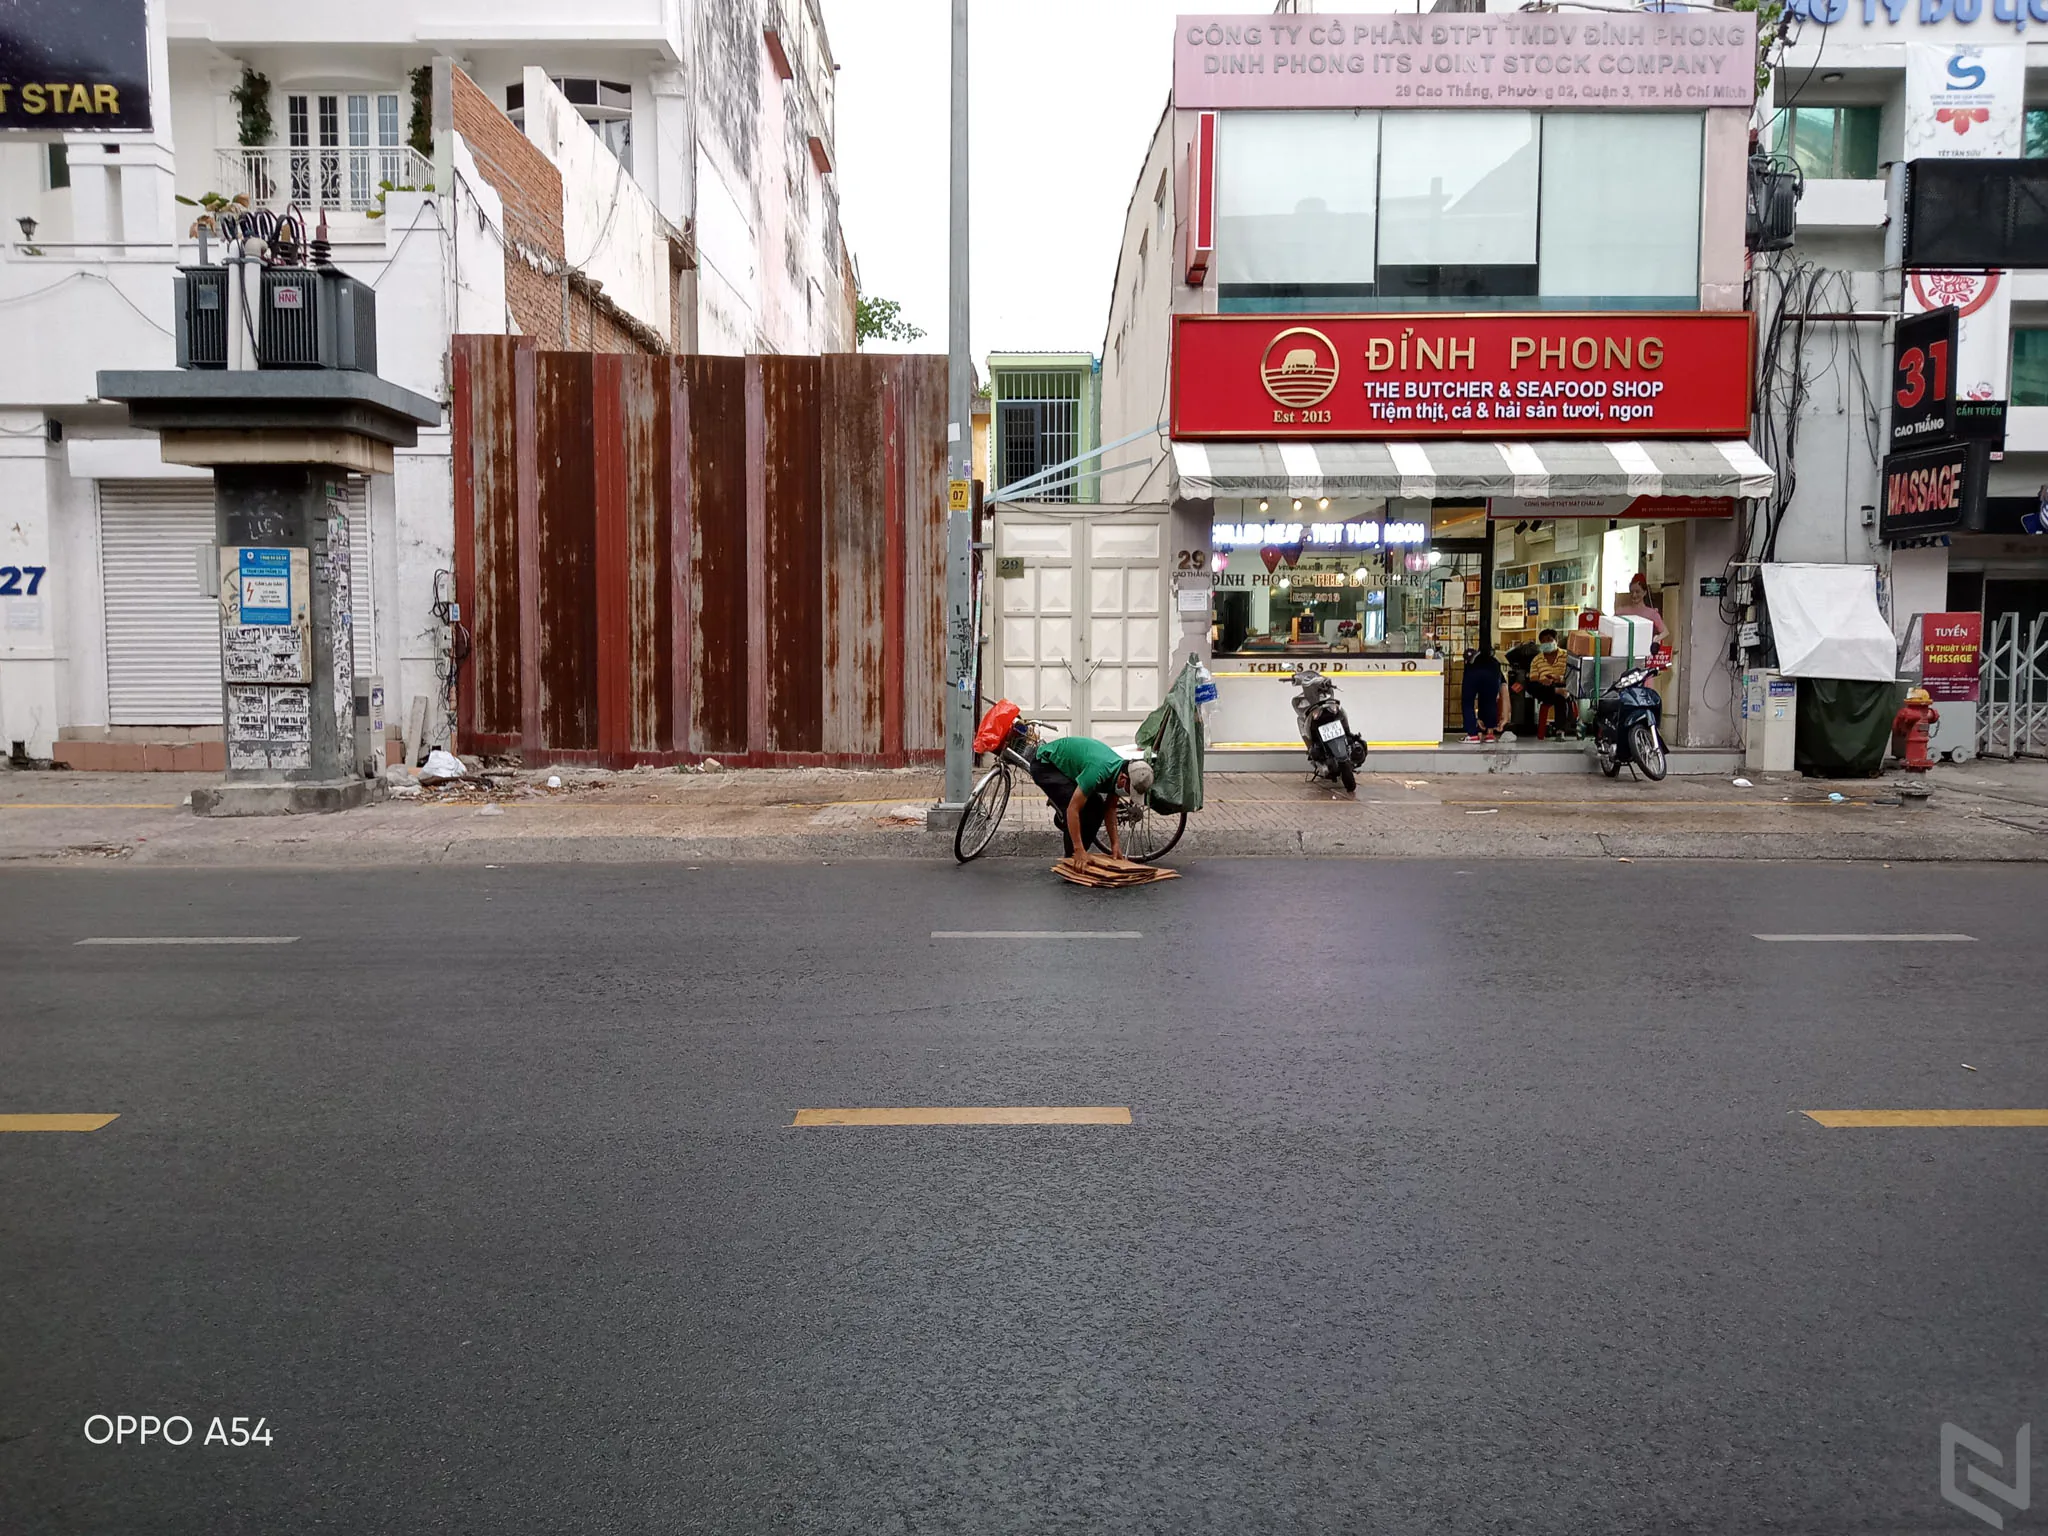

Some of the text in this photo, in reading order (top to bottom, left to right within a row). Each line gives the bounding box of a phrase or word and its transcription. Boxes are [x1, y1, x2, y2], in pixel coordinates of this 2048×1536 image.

[1187, 23, 1262, 46] CÔNG
[1270, 25, 1301, 45] TY
[1309, 19, 1346, 46] CỔ
[1353, 20, 1423, 45] PHẦN
[1431, 25, 1498, 45] ĐTPT
[1505, 25, 1577, 45] TMDV
[1652, 27, 1746, 47] PHONG
[1204, 55, 1727, 74] DINH PHONG ITS JOINT STOCK COMPANY
[22, 83, 120, 115] STAR
[1395, 86, 1411, 97] 29
[1416, 85, 1443, 97] Cao
[1497, 86, 1553, 100] Phườg
[1582, 86, 1618, 100] Quận
[1664, 85, 1682, 98] Hồ
[1687, 86, 1709, 98] Chí
[1365, 328, 1664, 371] ĐỈNH PHONG
[1896, 339, 1948, 409] 31
[1364, 381, 1664, 398] THE BUTCHER & SEAFOOD SHOP
[1302, 410, 1332, 423] 2013
[1369, 401, 1654, 422] Tiệm thịt, cá & hải sản tươi, ngon
[1894, 414, 1945, 438] CAO THẮNG
[953, 490, 964, 500] 07
[1888, 463, 1962, 516] MASSAGE
[1001, 560, 1018, 570] 29
[1178, 550, 1205, 570] 29
[0, 566, 46, 595] 27
[1929, 654, 1973, 664] MASSAGE
